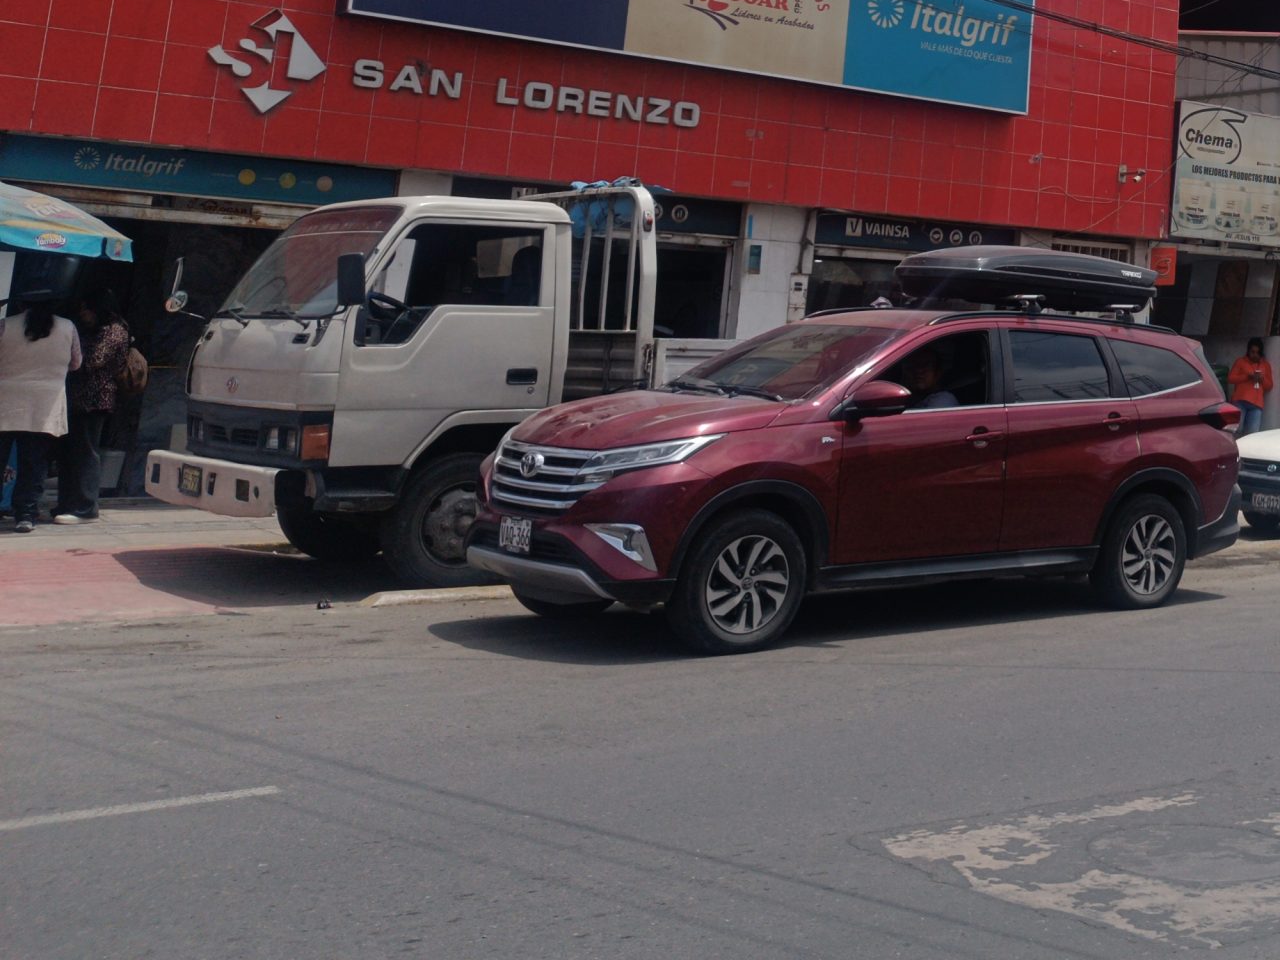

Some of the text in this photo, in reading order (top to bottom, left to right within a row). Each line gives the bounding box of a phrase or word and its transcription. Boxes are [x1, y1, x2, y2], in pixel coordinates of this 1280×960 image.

[775, 16, 814, 30] Acabados
[910, 0, 1018, 47] Italgrif
[920, 40, 936, 51] VALE
[953, 47, 963, 56] DE
[974, 50, 989, 61] QUE
[352, 58, 700, 129] SAN LORENZO
[1185, 128, 1234, 149] Chema
[104, 153, 187, 176] Italgrif
[1192, 164, 1203, 175] LOS
[1203, 166, 1228, 178] MEJORES
[1229, 169, 1262, 183] PRODUCTOS
[1263, 174, 1277, 184] PARA
[865, 221, 910, 239] VAINSA
